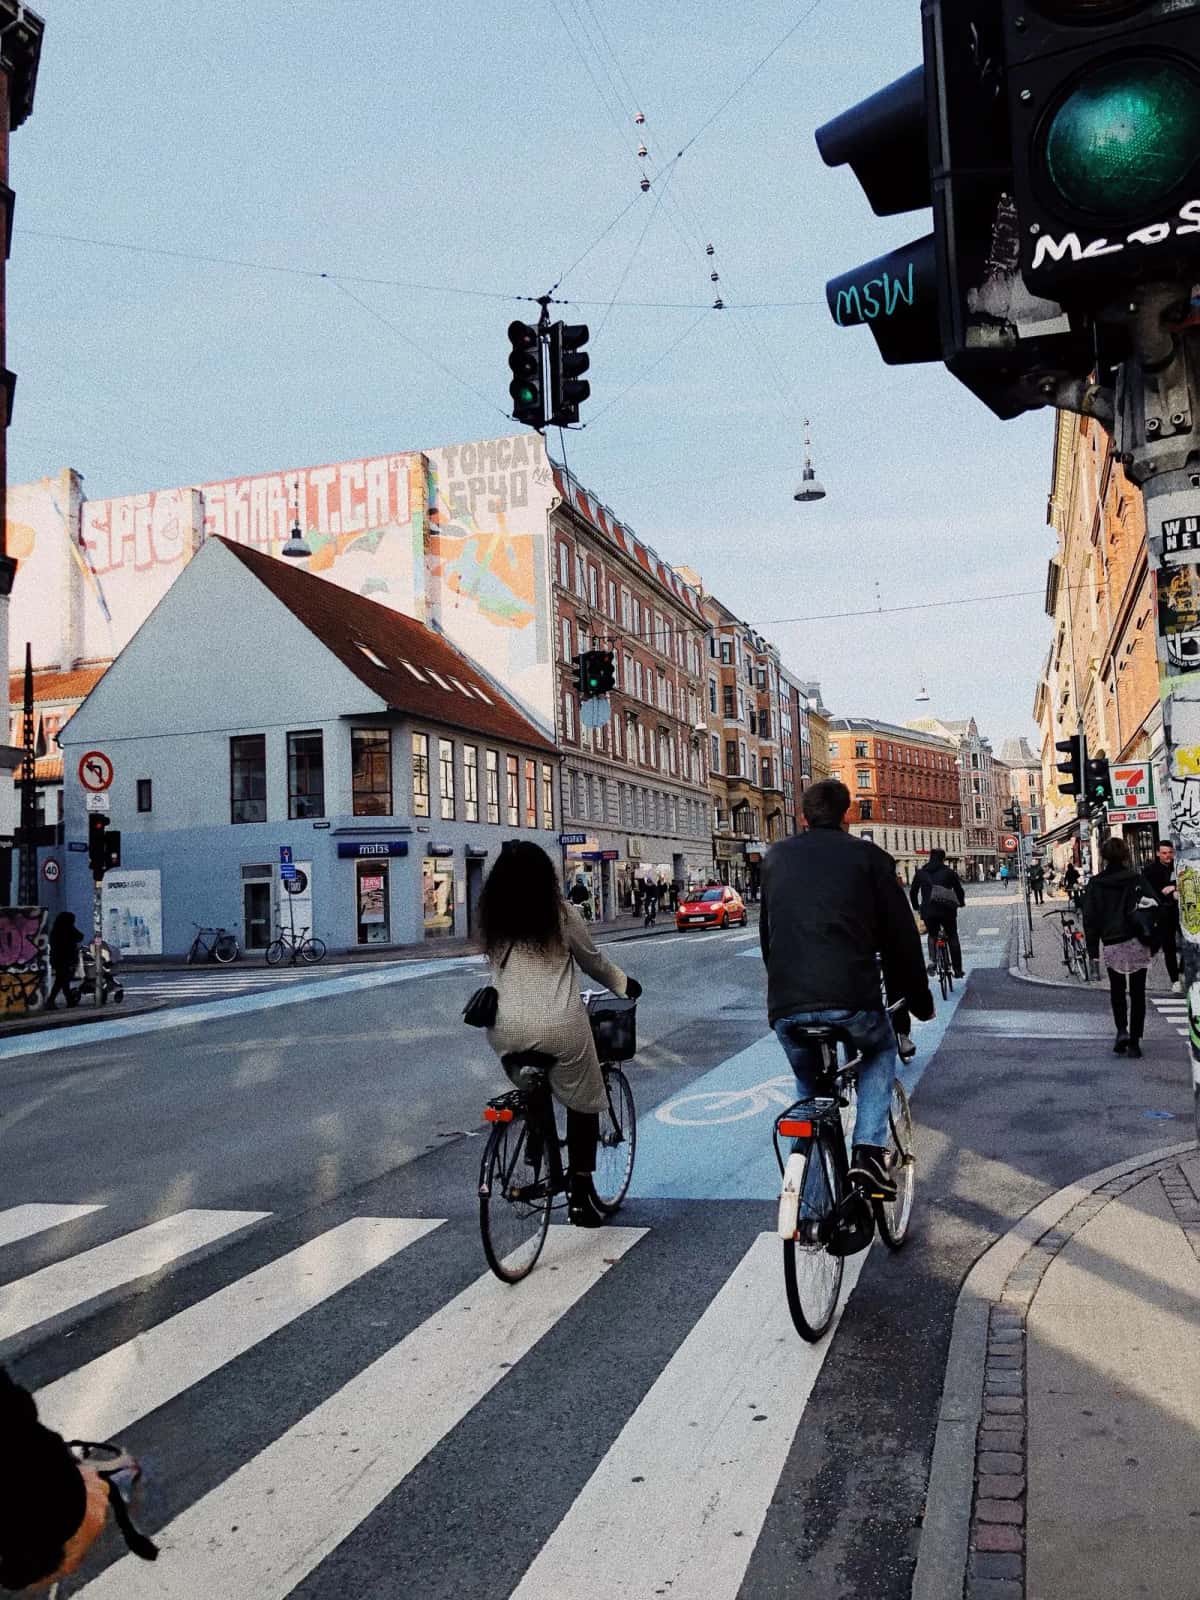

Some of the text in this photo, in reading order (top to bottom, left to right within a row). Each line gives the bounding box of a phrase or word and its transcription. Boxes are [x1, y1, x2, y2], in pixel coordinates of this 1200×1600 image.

[836, 262, 913, 325] MSW
[441, 433, 545, 478] TOMCAT
[1166, 532, 1200, 551] HE
[1115, 769, 1144, 807] 7
[359, 844, 390, 854] matas
[46, 865, 57, 875] 40
